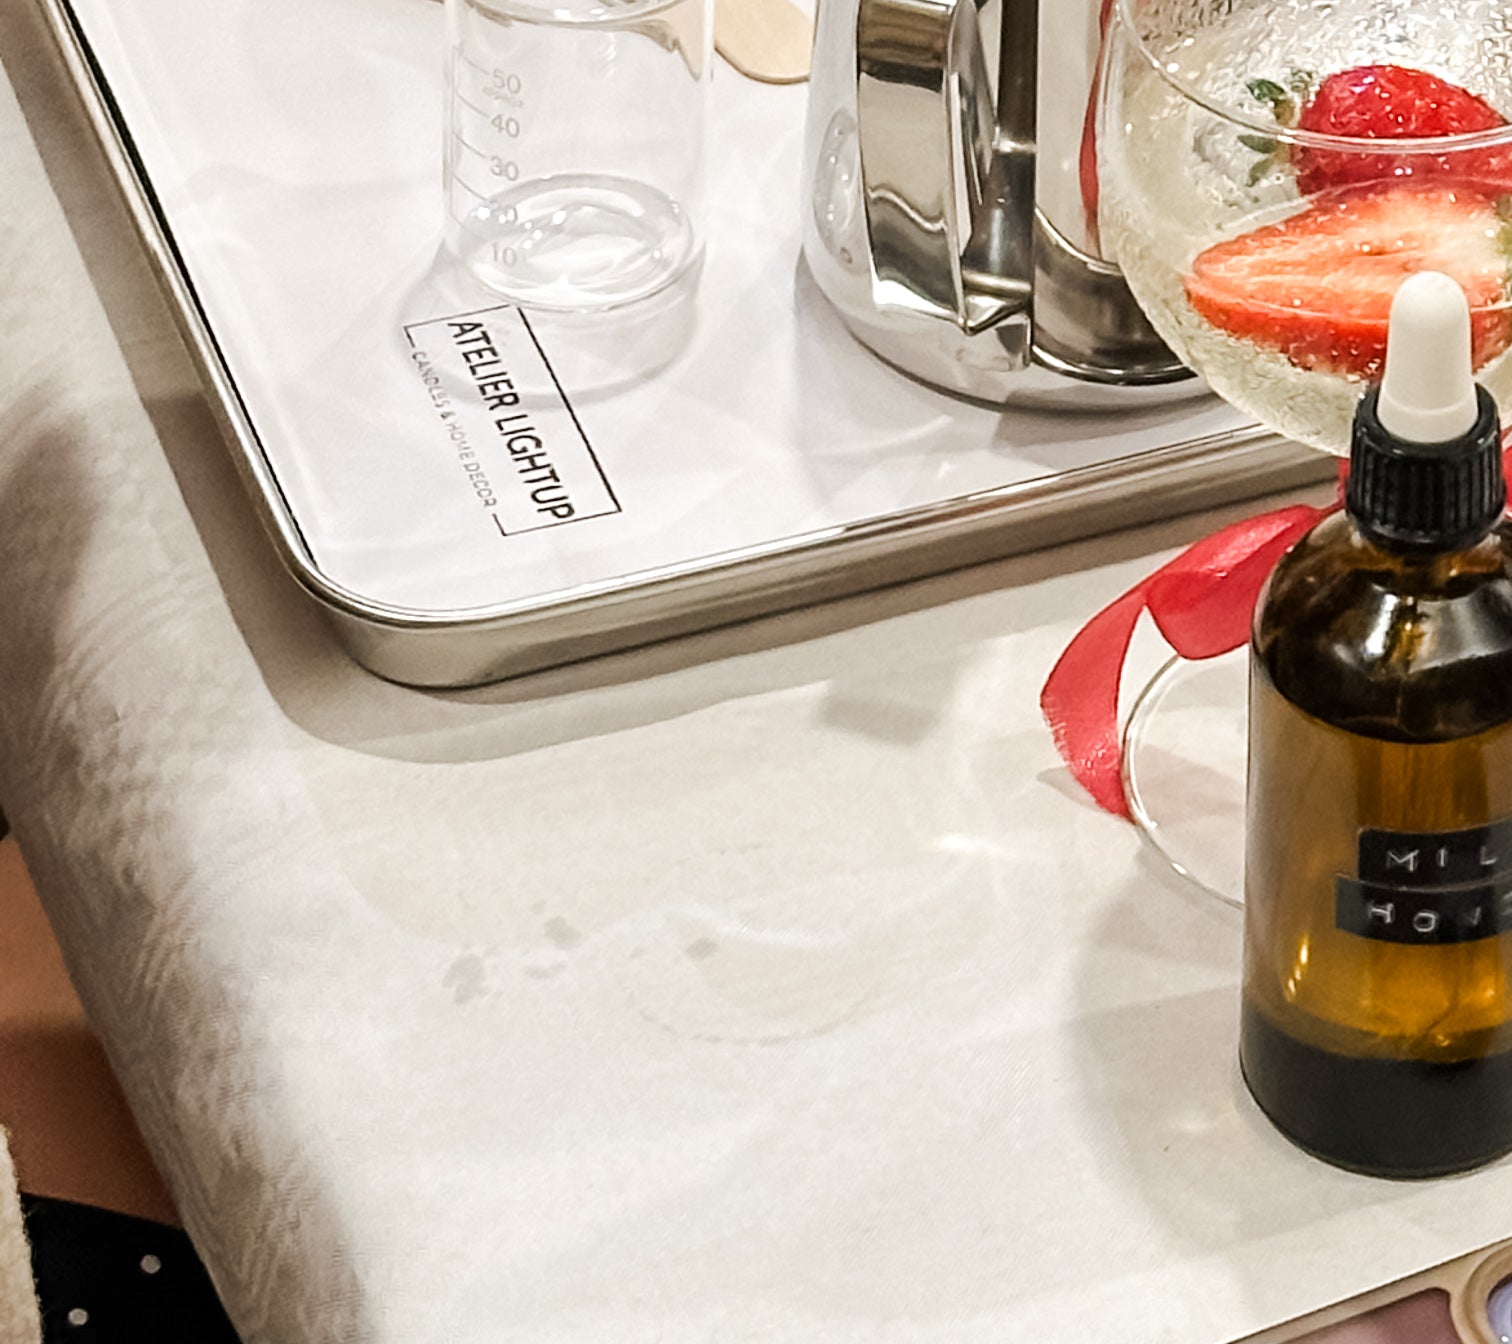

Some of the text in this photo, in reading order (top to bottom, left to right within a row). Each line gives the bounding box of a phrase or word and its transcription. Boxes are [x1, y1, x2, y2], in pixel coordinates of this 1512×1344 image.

[492, 69, 522, 95] 50
[490, 113, 520, 139] 40
[490, 155, 519, 182] 30
[491, 241, 518, 267] 10
[447, 321, 575, 520] ATELIER LIGHTUP
[443, 420, 476, 462] HOME
[463, 460, 498, 509] DECOR
